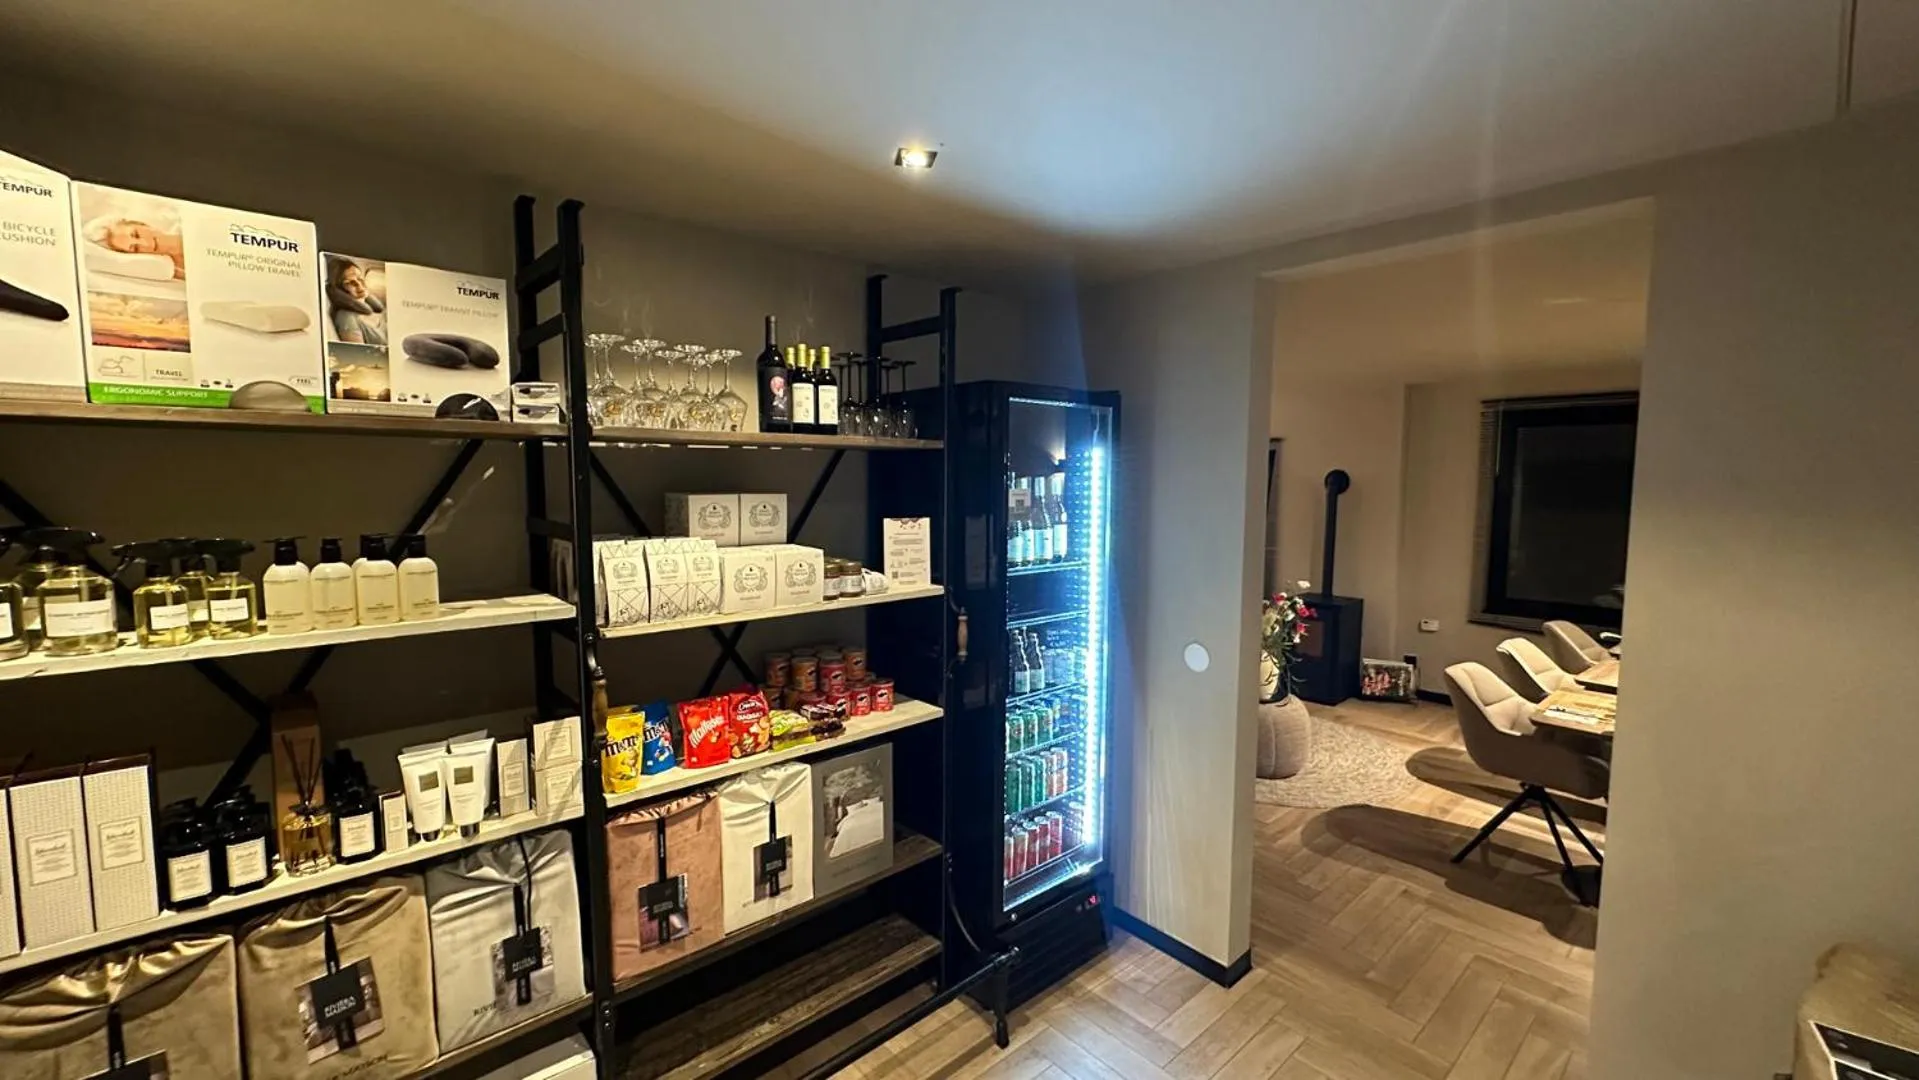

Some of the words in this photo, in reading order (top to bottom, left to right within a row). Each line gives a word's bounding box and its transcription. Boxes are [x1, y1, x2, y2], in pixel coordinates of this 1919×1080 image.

[0, 181, 53, 198] EMPUR
[3, 221, 56, 236] BICYCLE
[0, 232, 56, 246] USHION
[230, 232, 299, 253] TEMPUR
[256, 255, 301, 269] ORIGINAL
[228, 261, 265, 273] PILLOW
[268, 266, 301, 278] TRAVEL
[457, 286, 500, 300] TEMPUR
[166, 390, 208, 399] SUPPORT
